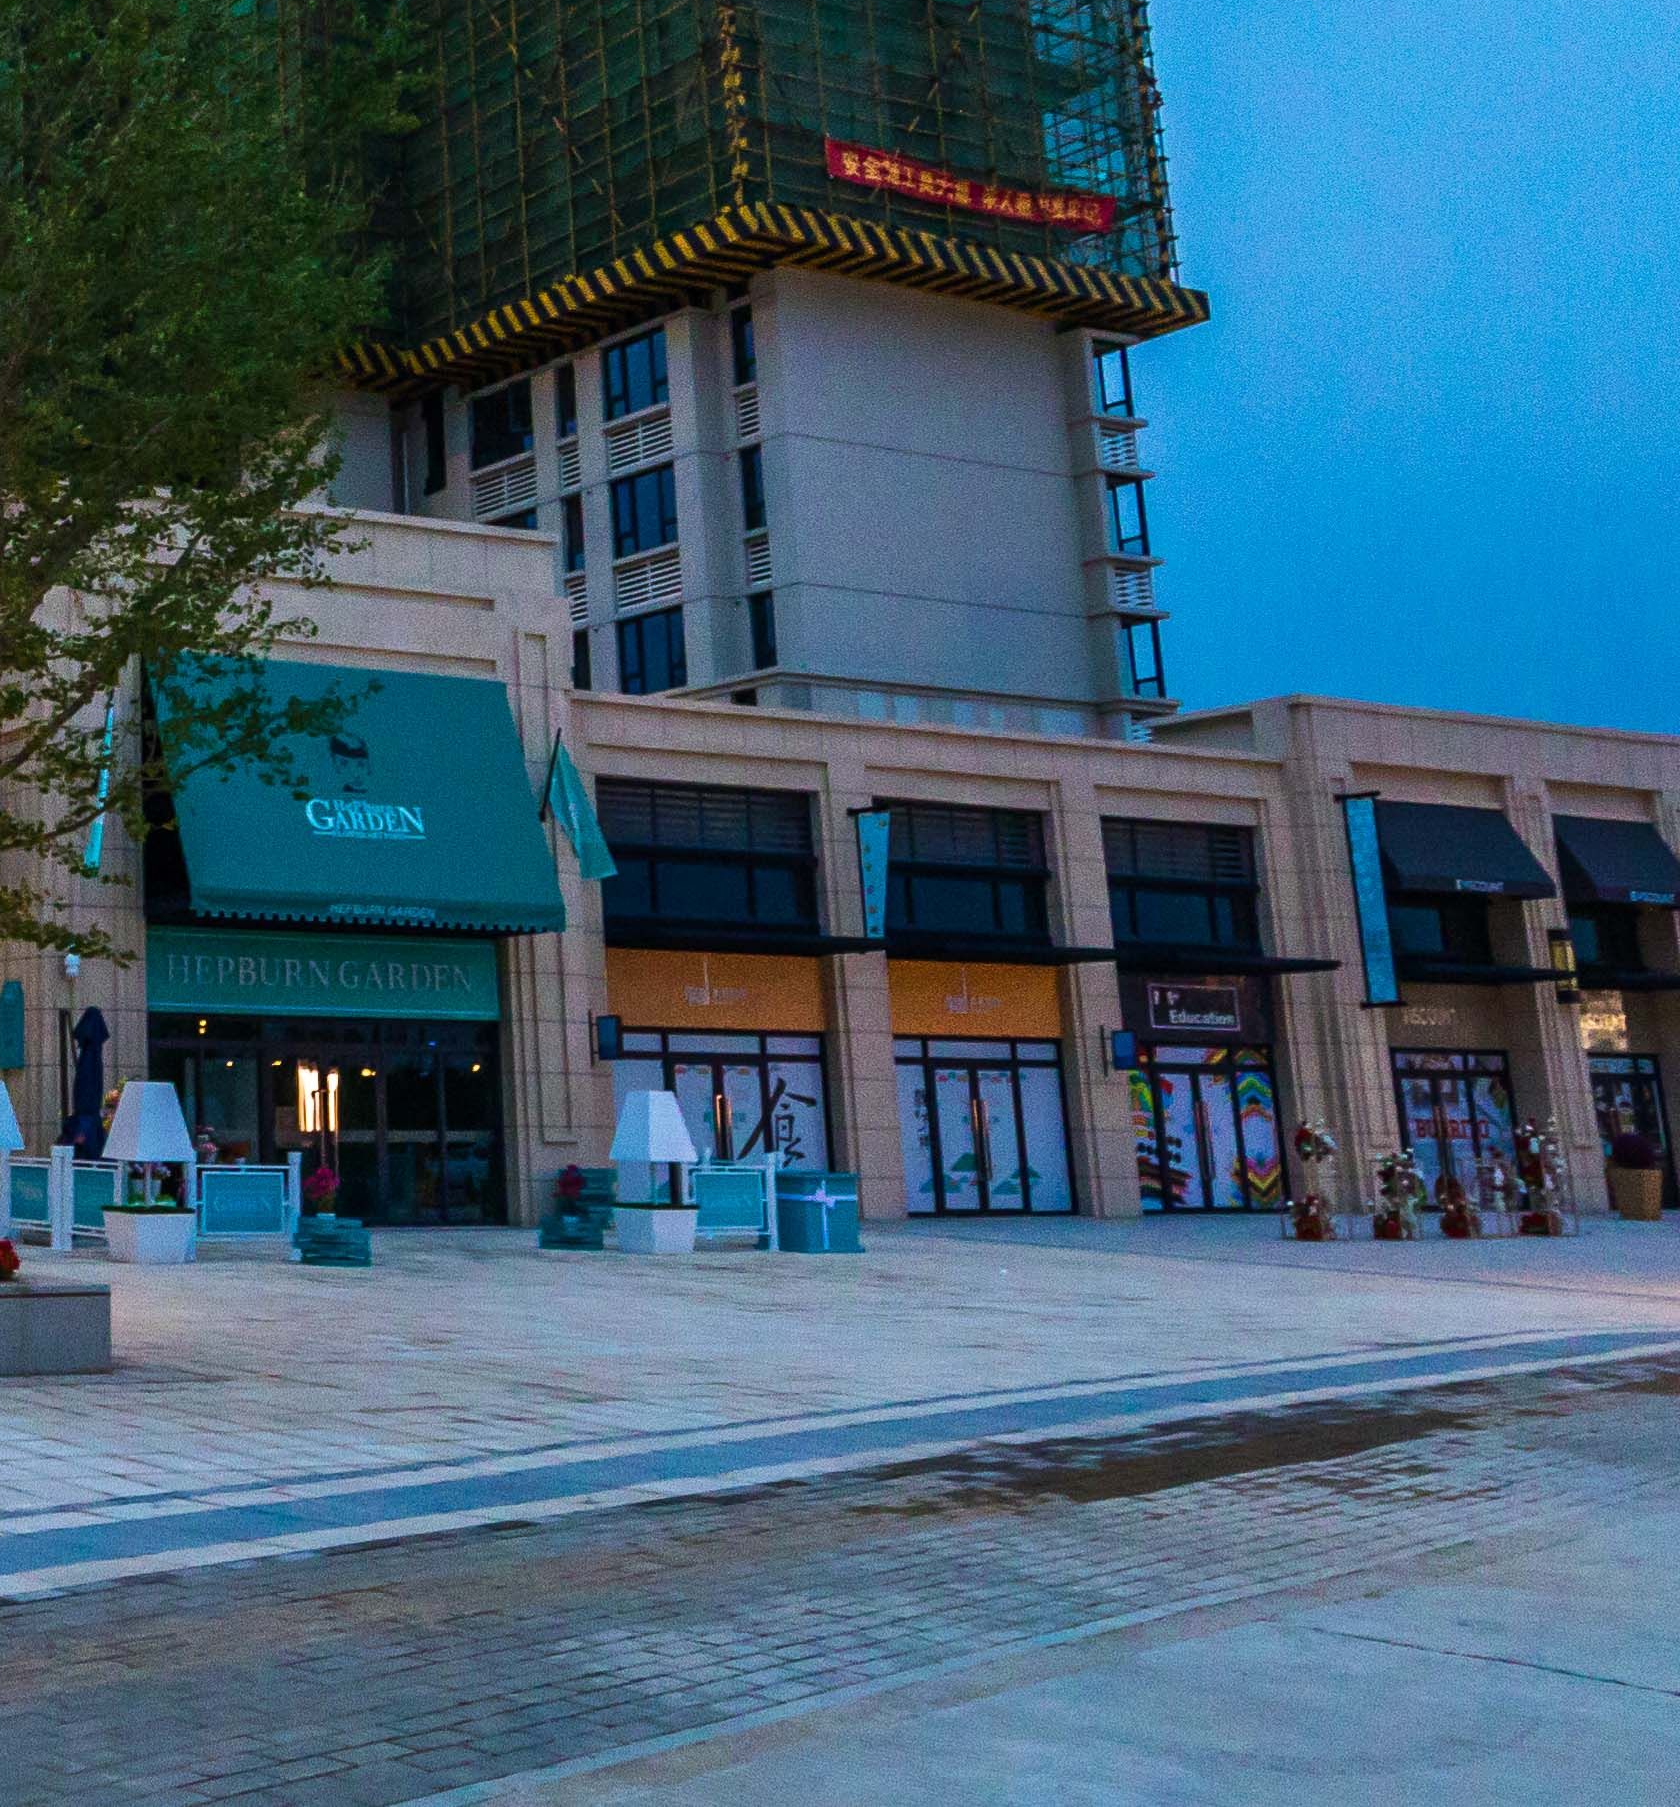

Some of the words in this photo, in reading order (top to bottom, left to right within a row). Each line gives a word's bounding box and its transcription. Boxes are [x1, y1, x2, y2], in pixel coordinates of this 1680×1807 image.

[166, 953, 331, 987] HEPBURN
[338, 959, 473, 993] GARDEN
[1169, 1009, 1236, 1025] Education
